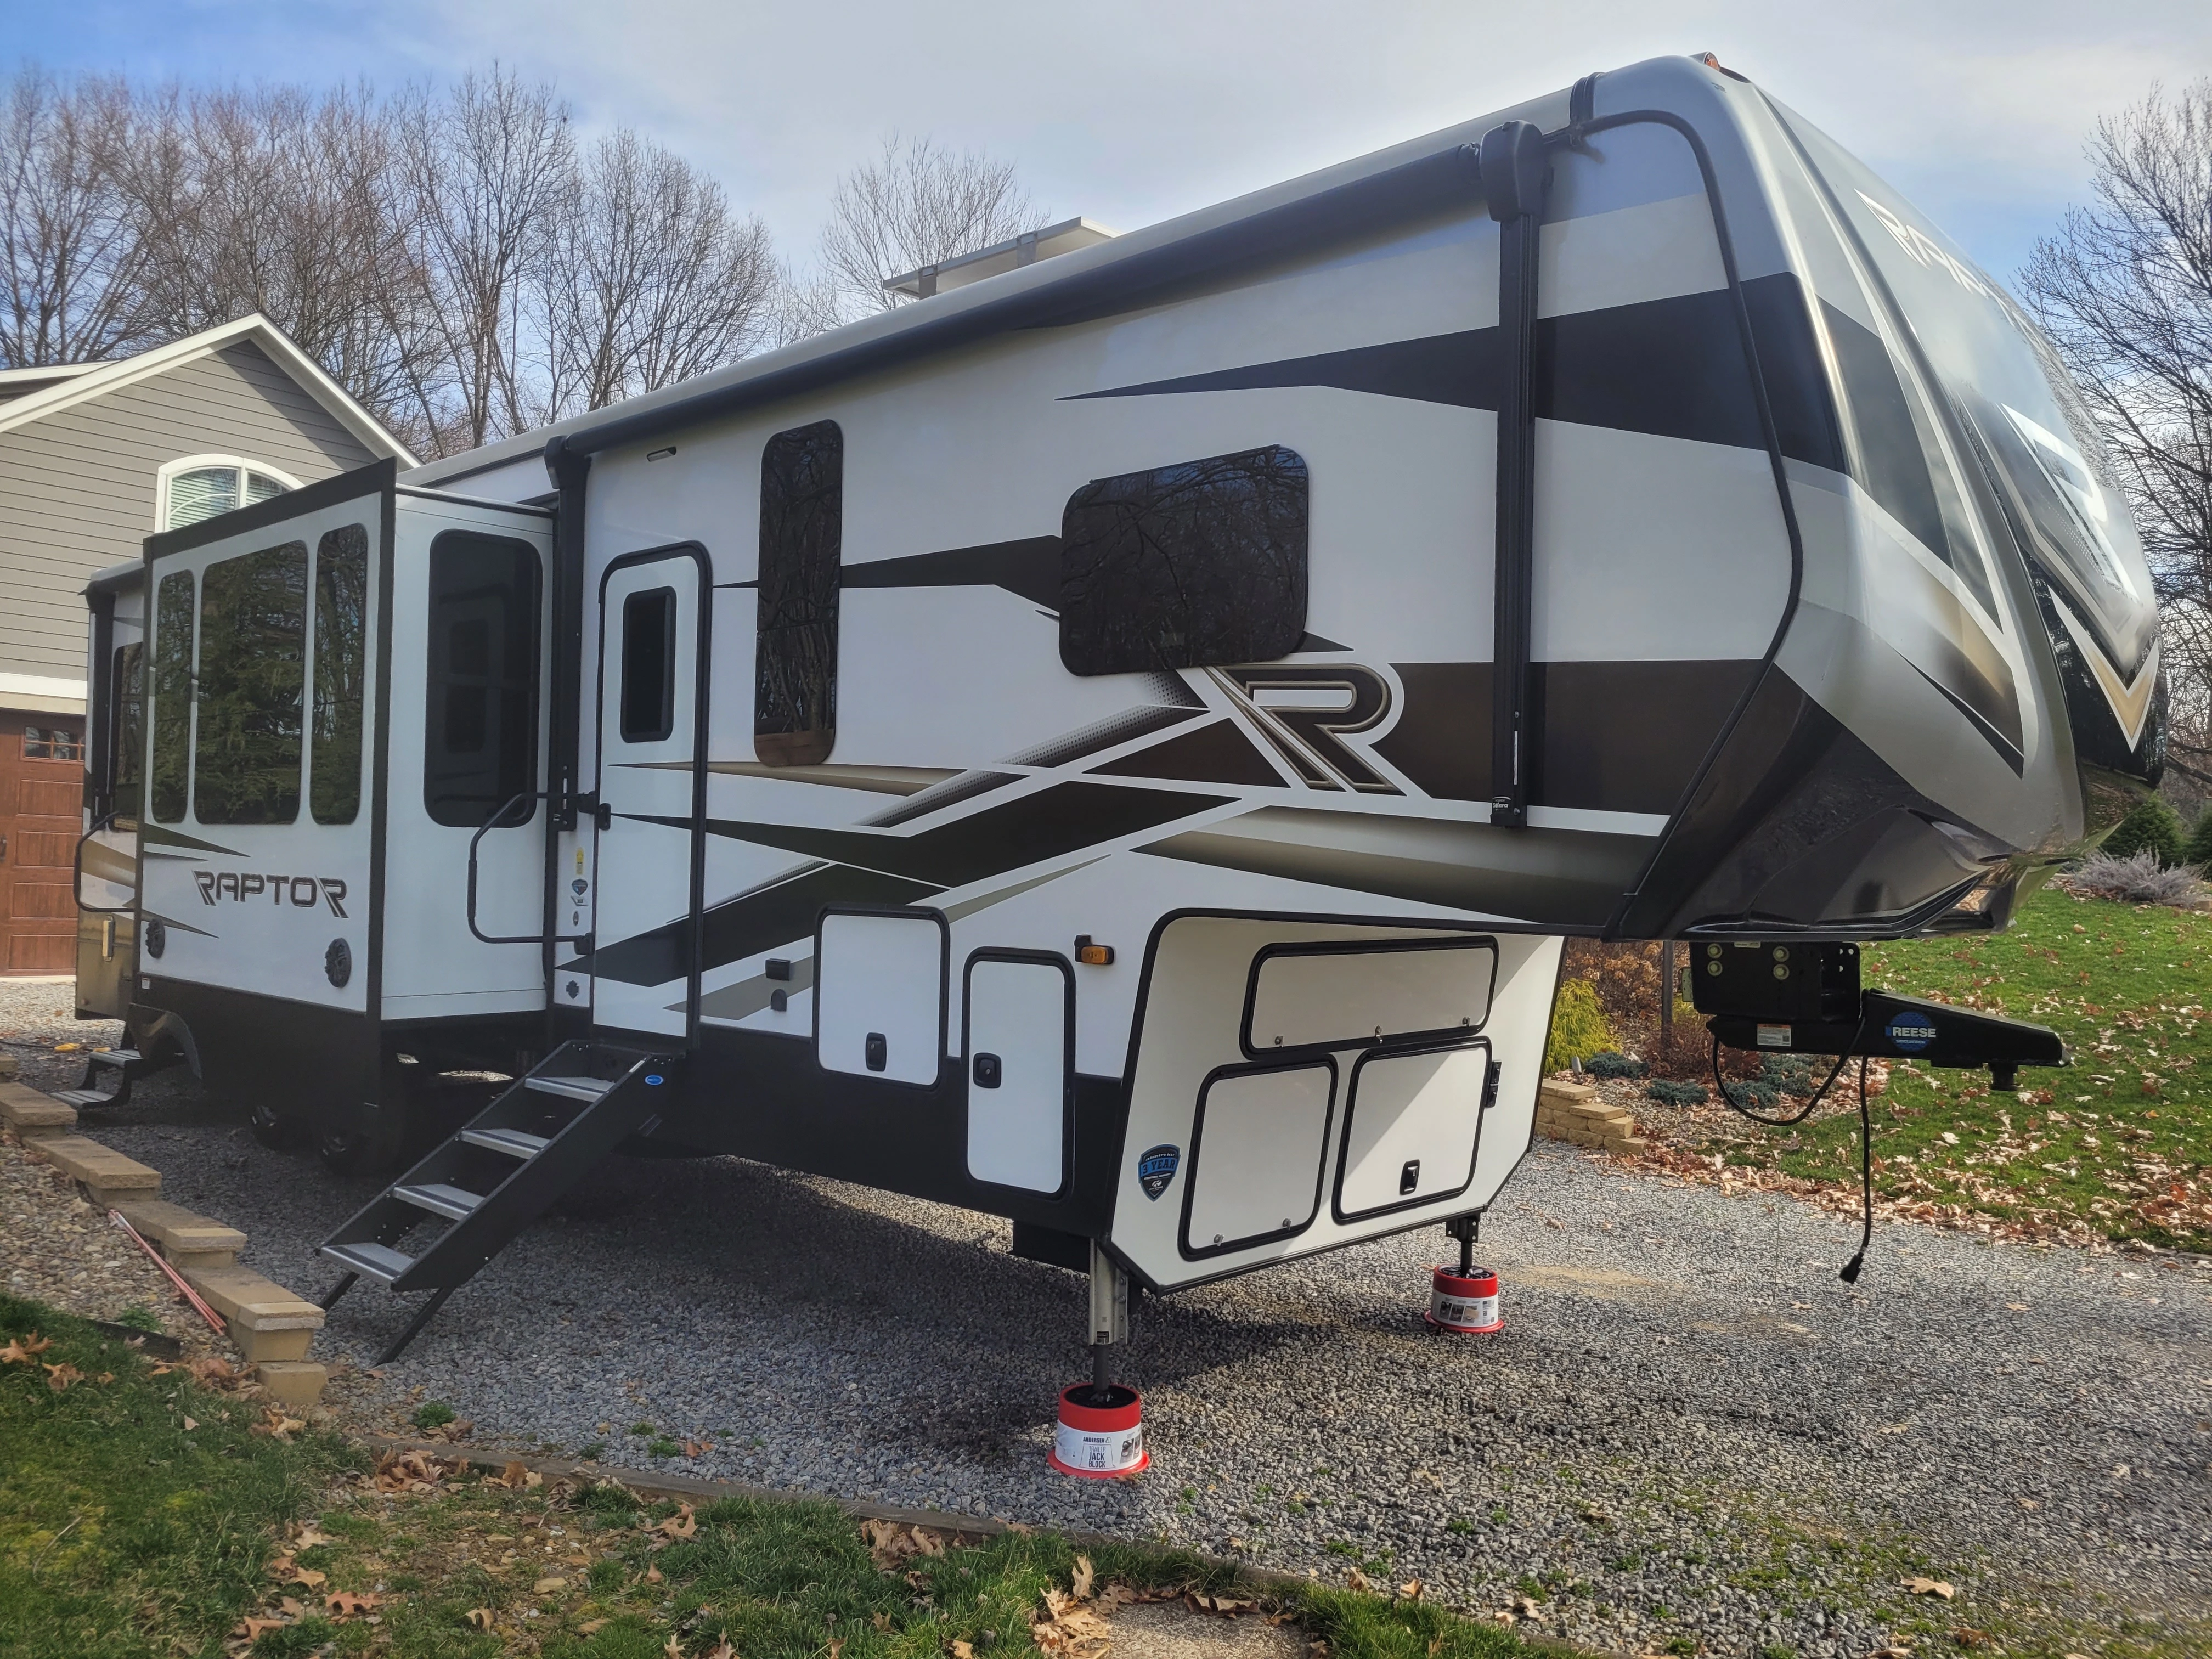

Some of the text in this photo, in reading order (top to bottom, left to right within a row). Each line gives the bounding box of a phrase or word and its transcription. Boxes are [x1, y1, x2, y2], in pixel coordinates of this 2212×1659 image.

[1203, 663, 1408, 797] R
[191, 869, 349, 919] RAPTOR
[1892, 1026, 1937, 1038] REESE
[1143, 1159, 1176, 1174] 3 YEAR
[1088, 1452, 1105, 1461] JACK
